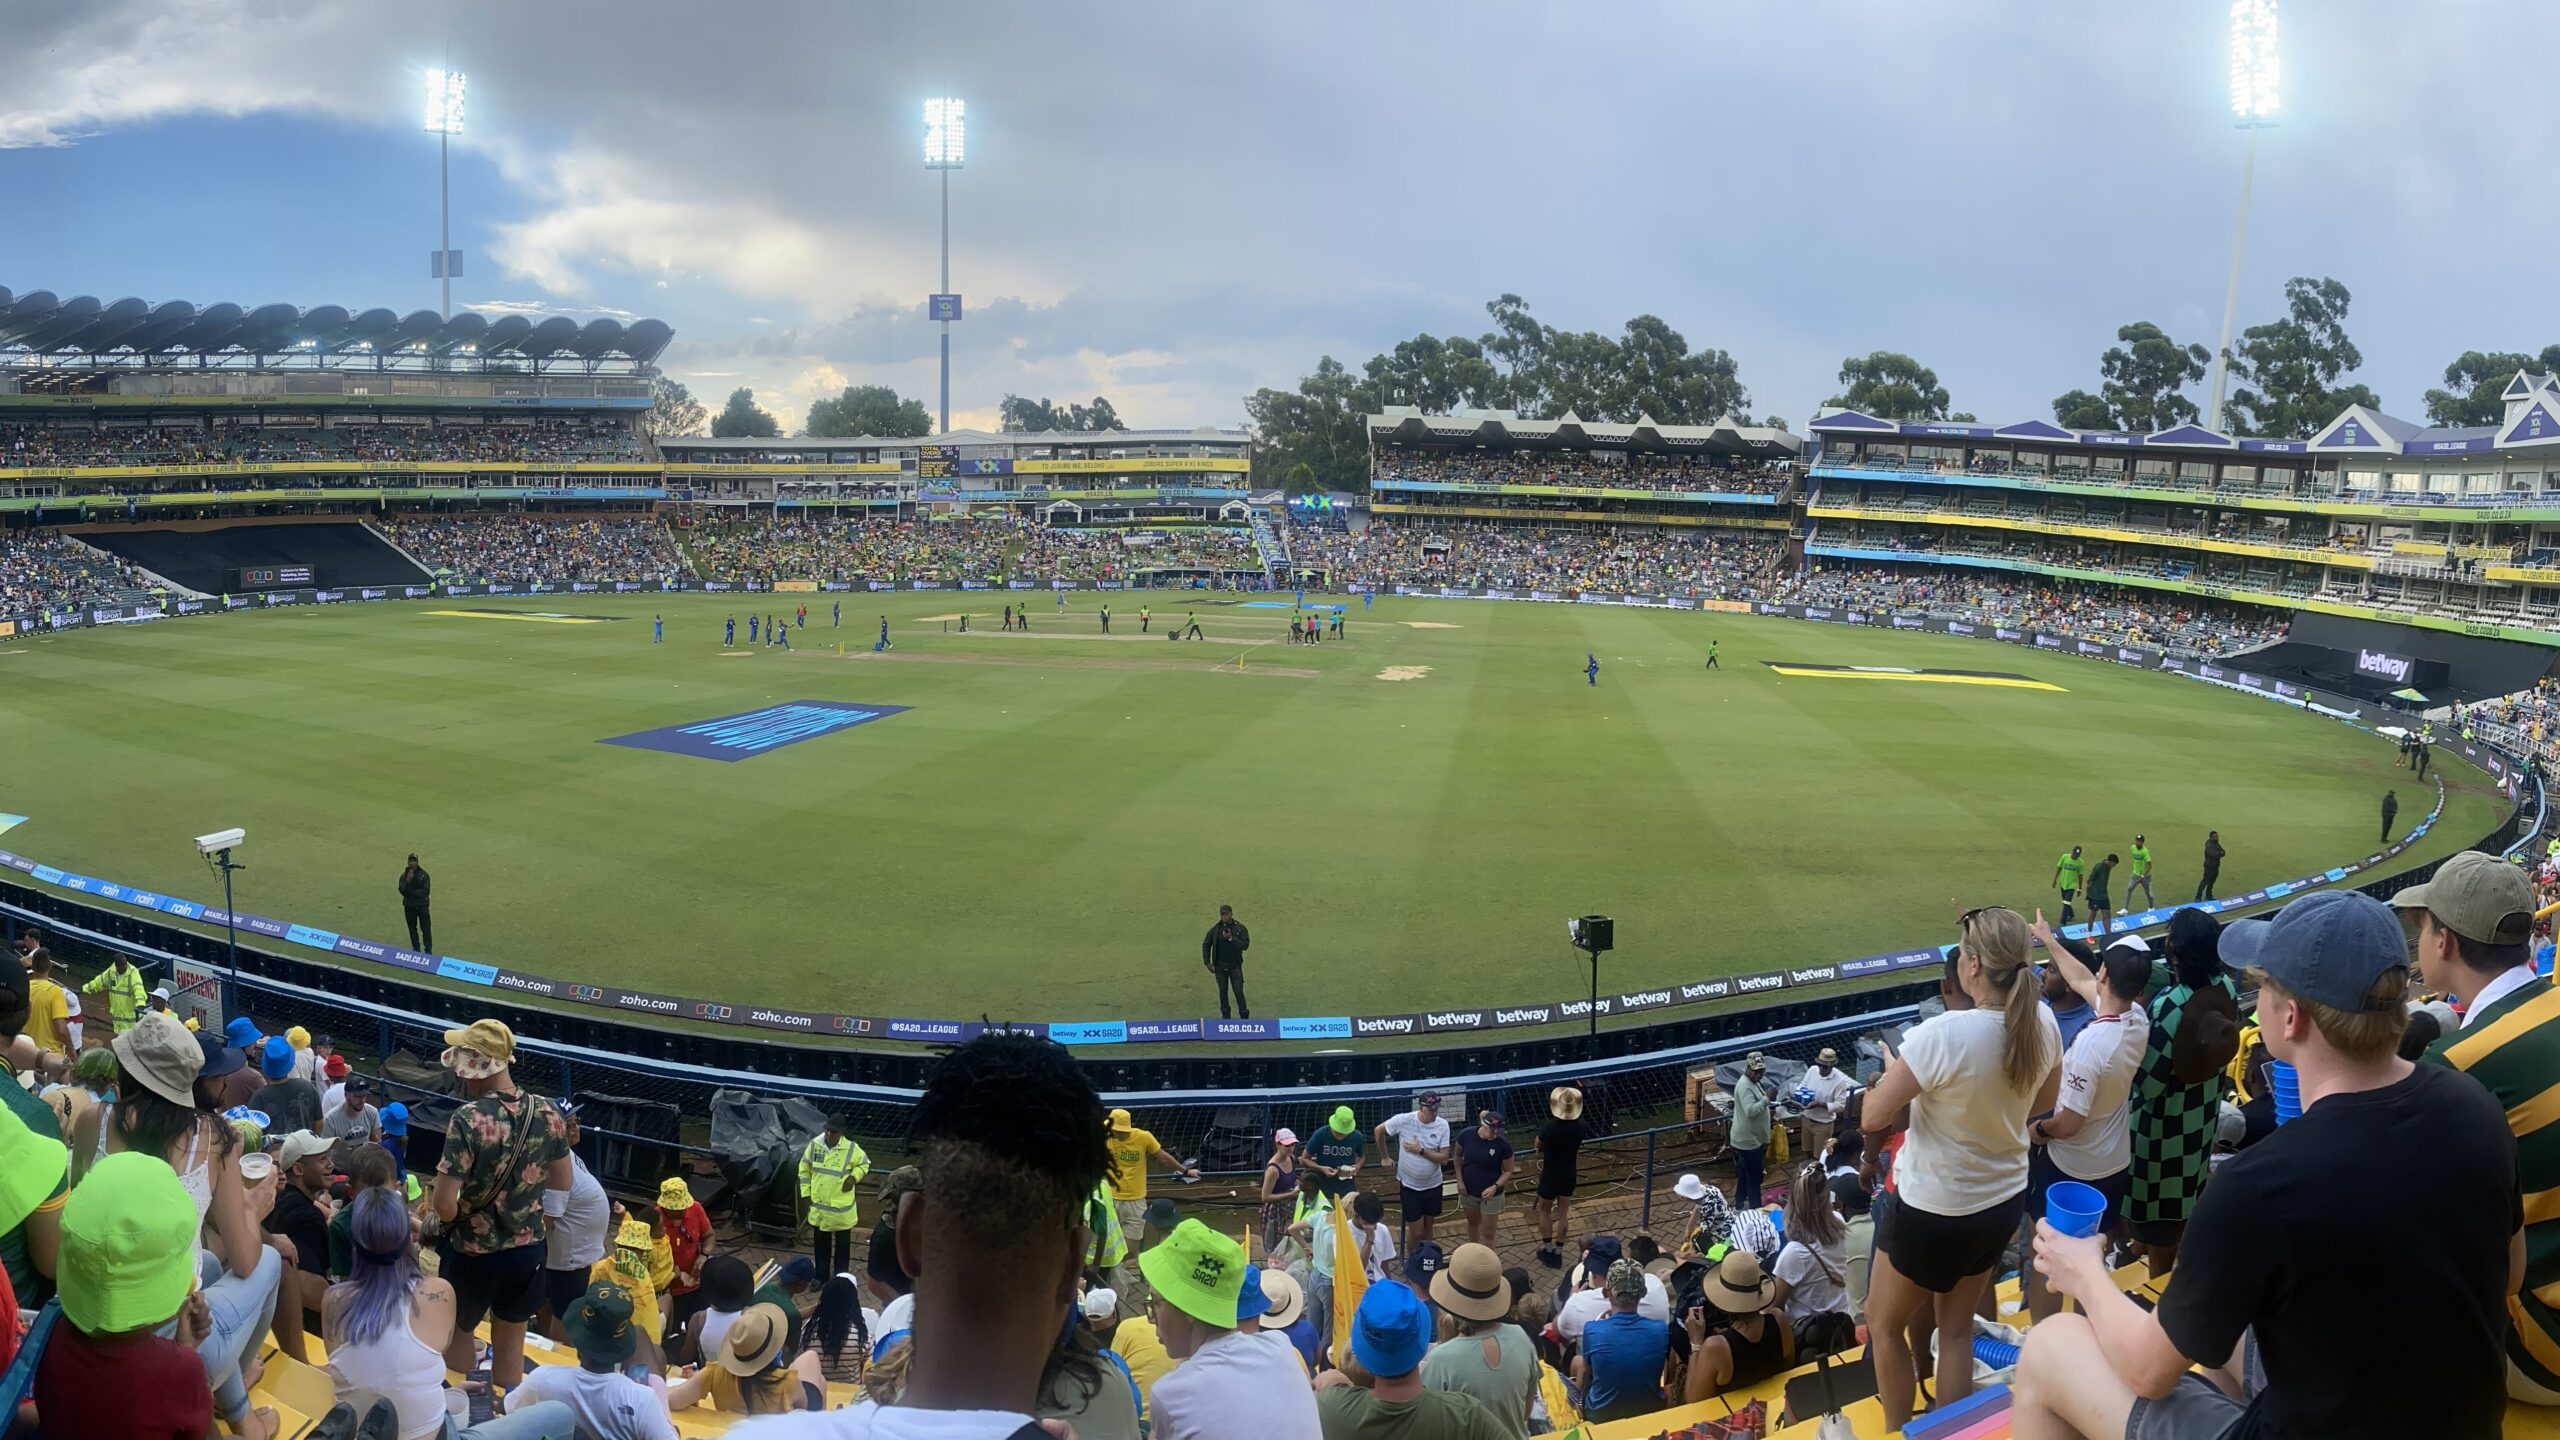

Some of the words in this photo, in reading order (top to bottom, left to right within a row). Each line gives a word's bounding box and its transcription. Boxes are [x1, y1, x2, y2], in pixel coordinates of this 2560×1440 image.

[2311, 553, 2332, 562] BELONG
[2360, 649, 2409, 682] betway
[68, 877, 86, 889] rain
[100, 884, 120, 897] rain
[135, 893, 155, 906] rain
[170, 903, 192, 916] rain
[204, 909, 243, 924] @SA20_LEGUE
[251, 920, 280, 933] SA20.CO.ZA
[2140, 914, 2159, 927] rain
[396, 952, 430, 965] SA20.CO.ZA
[477, 969, 494, 980] SA20
[498, 972, 552, 993] zoho.com
[1739, 973, 1784, 992] betway
[1792, 965, 1835, 984] betway
[1681, 980, 1729, 999] betway
[620, 994, 678, 1011] zoho.com
[1622, 989, 1672, 1008] betway
[1497, 1006, 1550, 1024] betway
[1561, 998, 1611, 1017] betway
[752, 1009, 813, 1027] zoho.com
[1358, 1016, 1414, 1034] betway
[1427, 1010, 1482, 1028] betway
[1052, 1029, 1078, 1038] betway
[1102, 1028, 1123, 1038] SA20
[1218, 1023, 1266, 1034] SA20.CO.ZA
[1283, 1024, 1307, 1033] betway
[1328, 1022, 1348, 1032] SA20
[1323, 1145, 1353, 1157] BOSS
[1192, 1268, 1218, 1288] SA20
